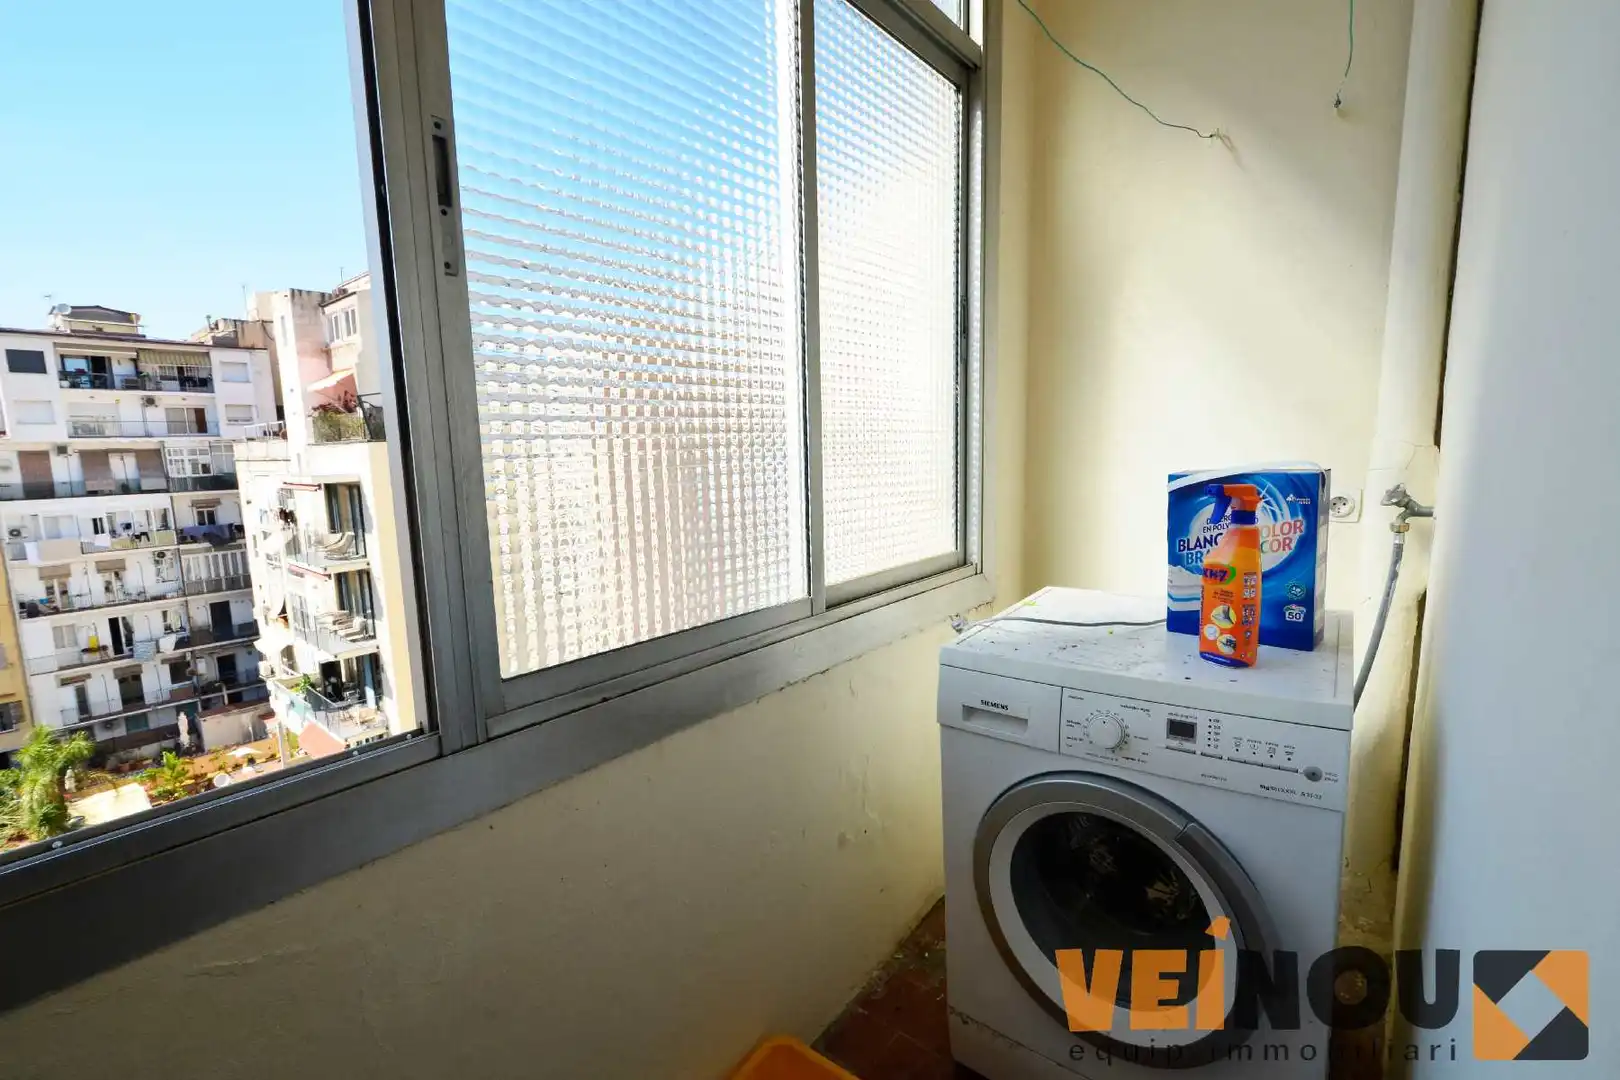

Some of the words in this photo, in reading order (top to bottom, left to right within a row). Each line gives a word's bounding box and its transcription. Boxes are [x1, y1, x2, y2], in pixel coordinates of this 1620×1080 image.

[1213, 522, 1230, 531] POLV
[1260, 519, 1304, 538] OLOR
[1178, 533, 1223, 552] BLANC
[1261, 537, 1292, 553] COR
[1287, 612, 1301, 620] 50
[980, 699, 1009, 711] SIEMENS
